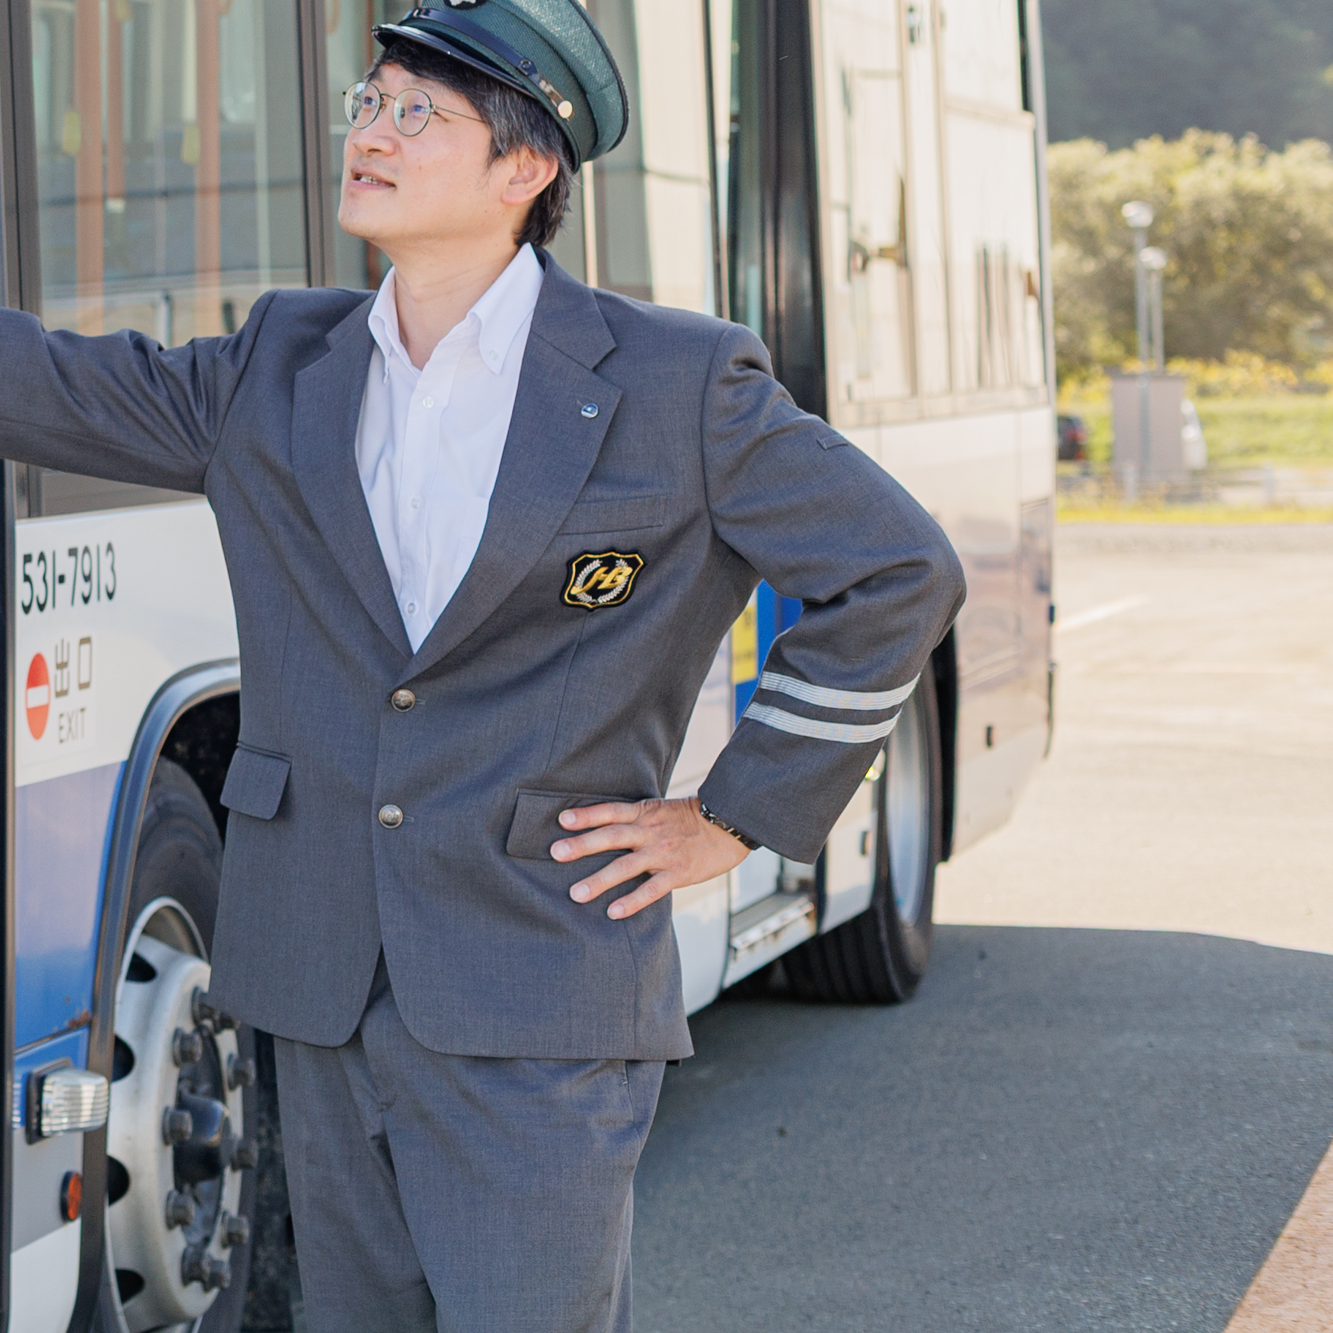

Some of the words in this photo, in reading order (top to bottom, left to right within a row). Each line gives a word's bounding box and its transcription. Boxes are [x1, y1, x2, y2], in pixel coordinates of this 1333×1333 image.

[21, 541, 117, 615] 531-7913
[54, 636, 93, 699] 出口
[58, 708, 86, 744] EXIT
